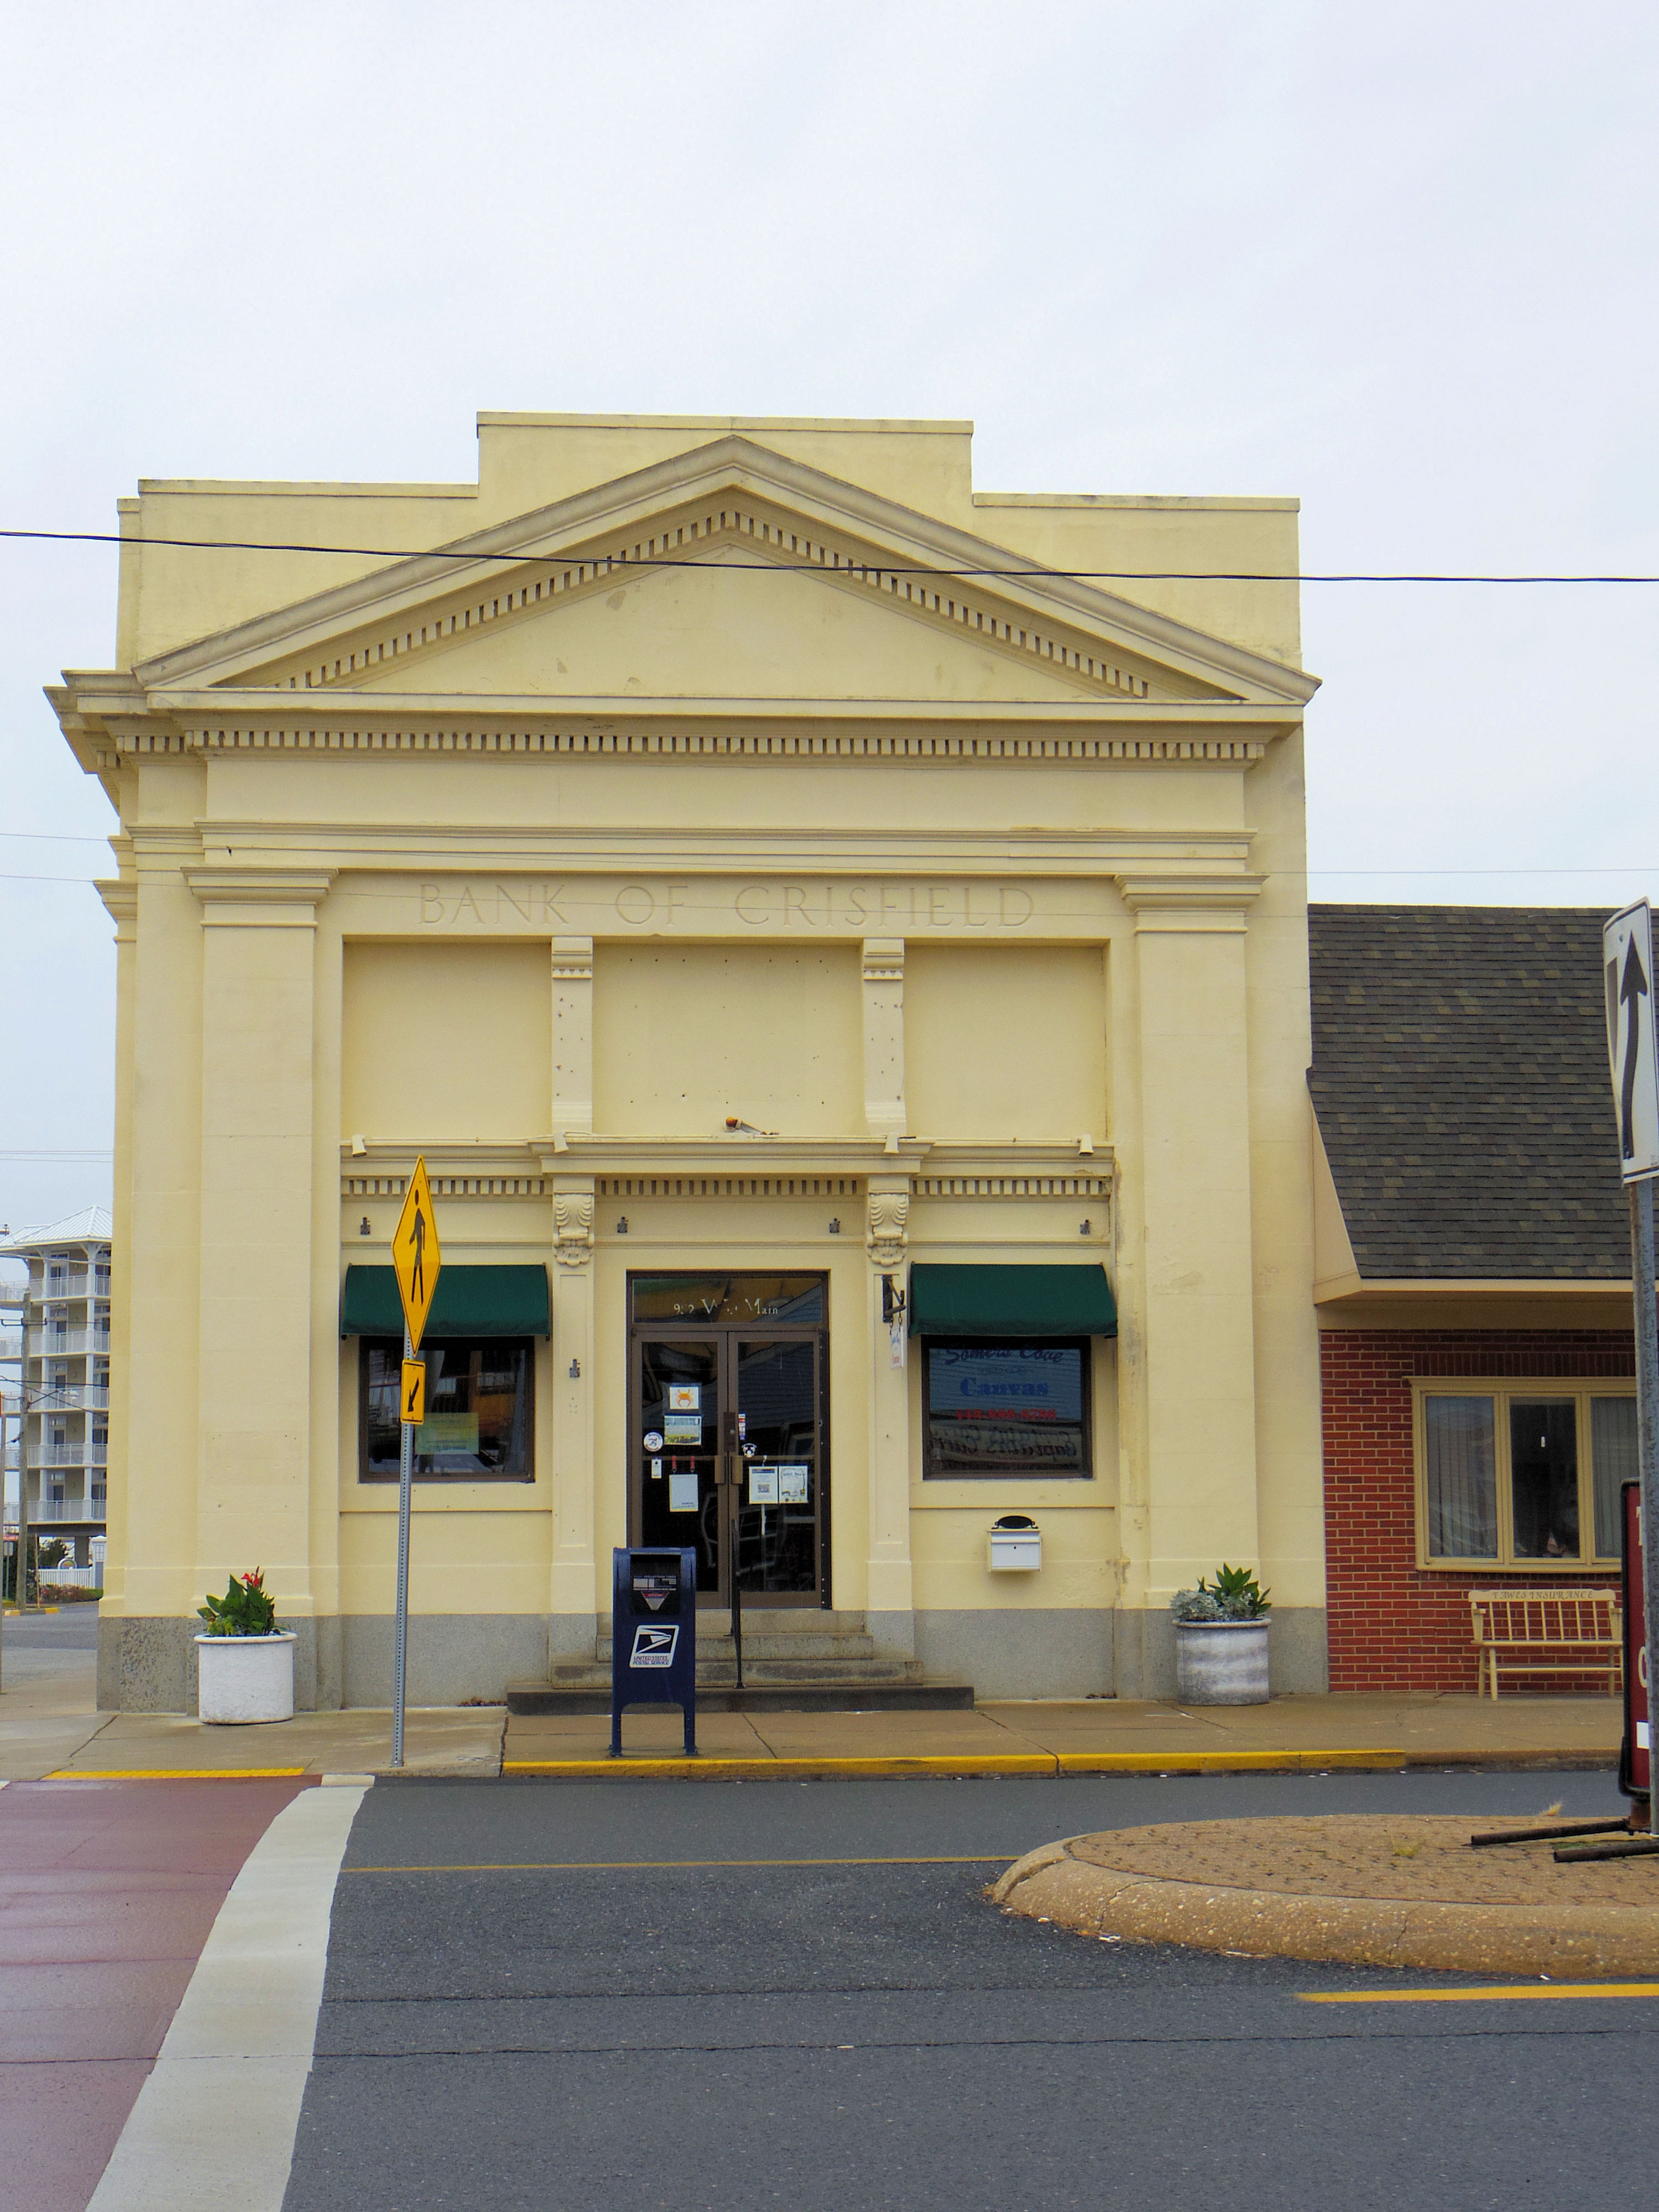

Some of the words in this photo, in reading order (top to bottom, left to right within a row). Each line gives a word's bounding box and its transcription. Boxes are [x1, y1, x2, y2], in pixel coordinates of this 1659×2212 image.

[419, 884, 571, 925] BANK
[615, 885, 688, 926] OF
[735, 886, 1035, 927] CRISFIELD
[960, 1377, 1048, 1397] Canvas
[1494, 1590, 1527, 1600] TAWES
[1529, 1590, 1593, 1600] INSURANCE
